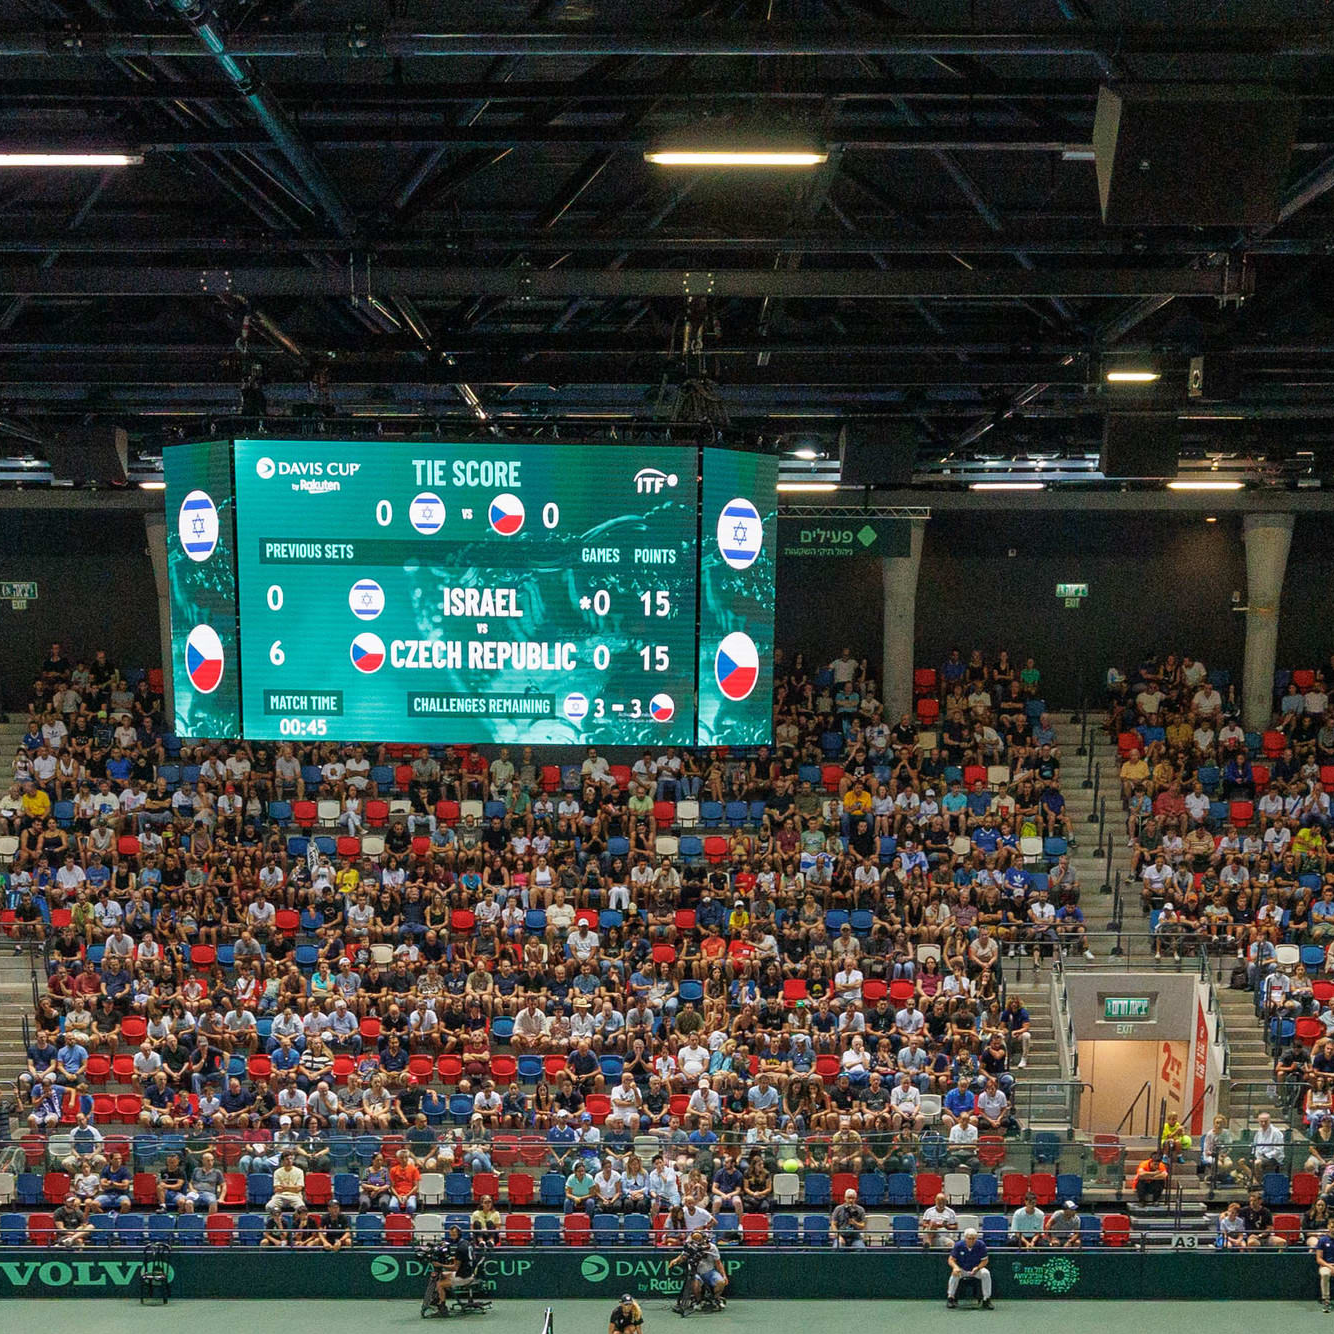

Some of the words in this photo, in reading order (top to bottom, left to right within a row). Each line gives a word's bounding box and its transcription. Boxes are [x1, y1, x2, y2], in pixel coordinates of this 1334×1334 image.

[278, 462, 323, 476] DAVIS
[326, 462, 359, 476] CUP
[412, 459, 446, 486] TIE
[452, 460, 521, 487] SCORE
[291, 482, 300, 491] by
[300, 479, 340, 492] Rakuten
[636, 477, 665, 494] ITF
[376, 499, 393, 526] 0
[542, 502, 560, 529] 0
[800, 527, 854, 545] פעילים
[266, 543, 322, 558] PREVIOUS
[324, 544, 354, 559] SETS
[581, 548, 620, 563] GAMES
[634, 548, 676, 564] POINTS
[267, 584, 284, 611] 0
[443, 587, 523, 617] ISRAEL
[640, 590, 670, 617] 15
[269, 640, 285, 666] 6
[390, 639, 462, 669] CZECH
[468, 640, 577, 671] REPUBLIC
[593, 644, 610, 670] 0
[639, 645, 670, 671] 15
[270, 695, 307, 710] MATCH
[310, 695, 337, 711] TIME
[413, 697, 486, 713] CHALLENGES
[489, 699, 550, 714] REMAINING
[593, 698, 605, 718] 3
[631, 698, 641, 719] 3
[279, 718, 327, 736] 00:45
[1116, 1024, 1134, 1035] EXIT
[1174, 1236, 1196, 1247] A3
[616, 1260, 684, 1277] DAVIS
